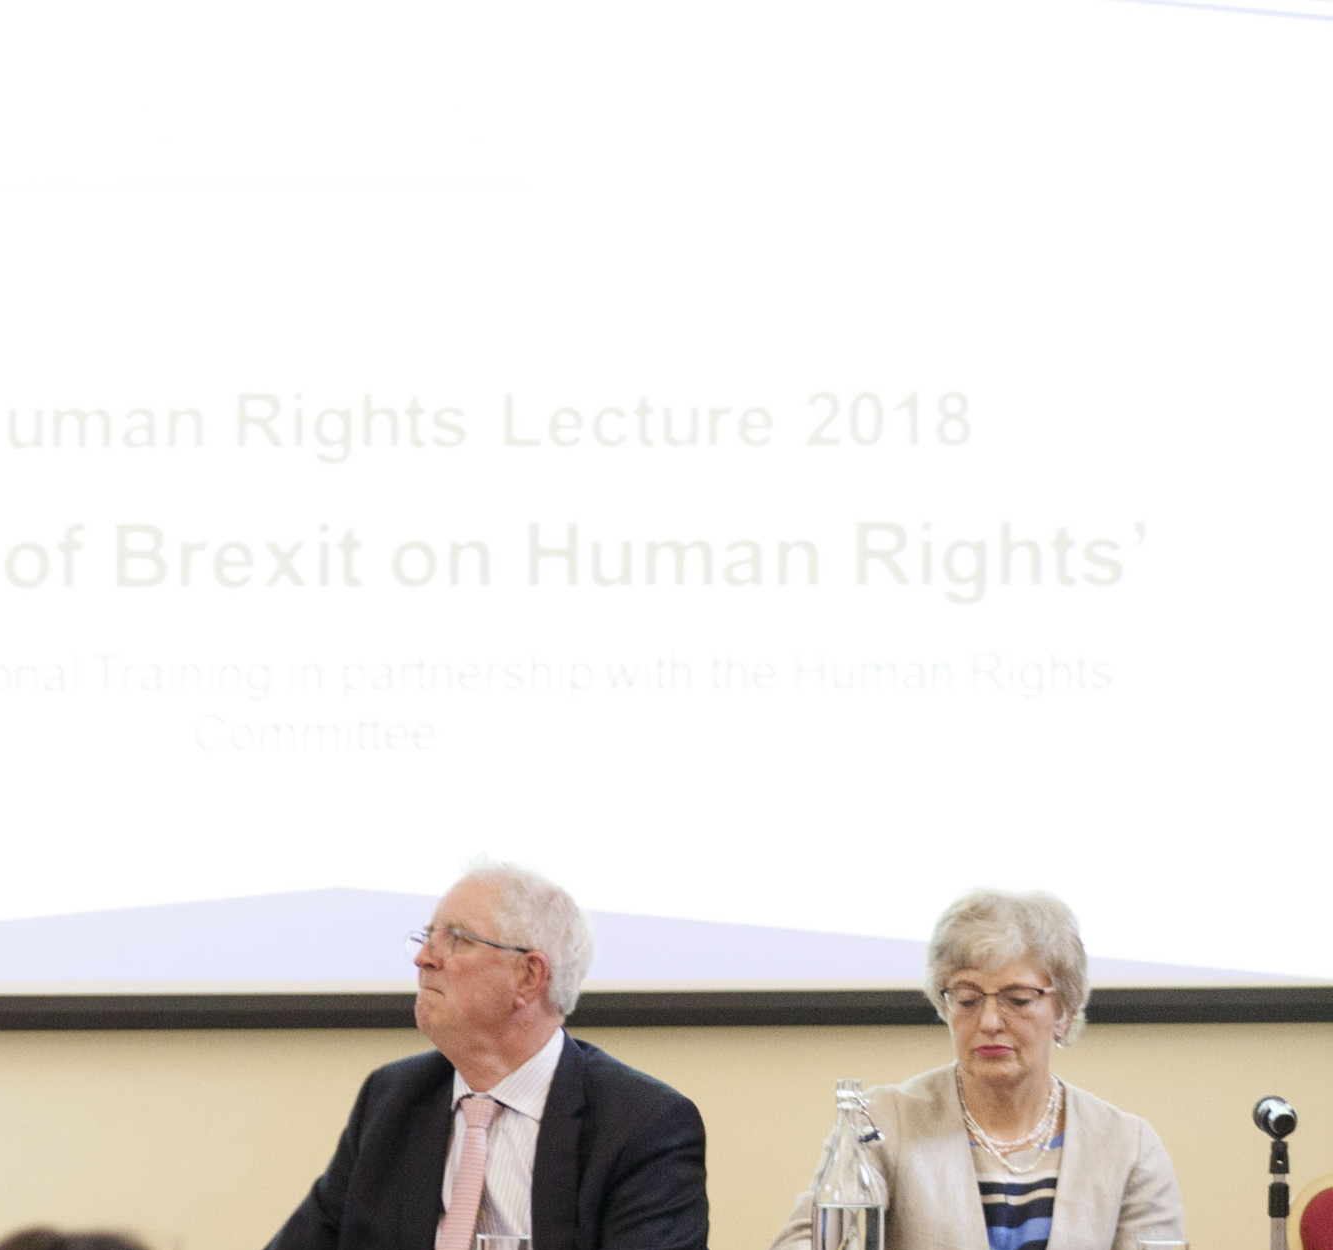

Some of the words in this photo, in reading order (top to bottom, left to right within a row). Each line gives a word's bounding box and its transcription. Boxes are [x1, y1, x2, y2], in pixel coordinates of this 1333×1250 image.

[236, 392, 468, 465] Rights
[503, 393, 774, 449] Lecture
[805, 391, 972, 448] 2018
[4, 524, 86, 590] of
[114, 523, 363, 589] Brexit
[390, 539, 492, 589] on
[527, 522, 820, 588] Human
[93, 653, 272, 702] Training
[288, 655, 323, 691] in
[341, 653, 595, 700] partnership
[605, 653, 693, 691] with
[710, 653, 777, 691] the
[794, 653, 954, 691] Human
[971, 652, 1114, 701] Rights
[193, 713, 438, 753] Committee
